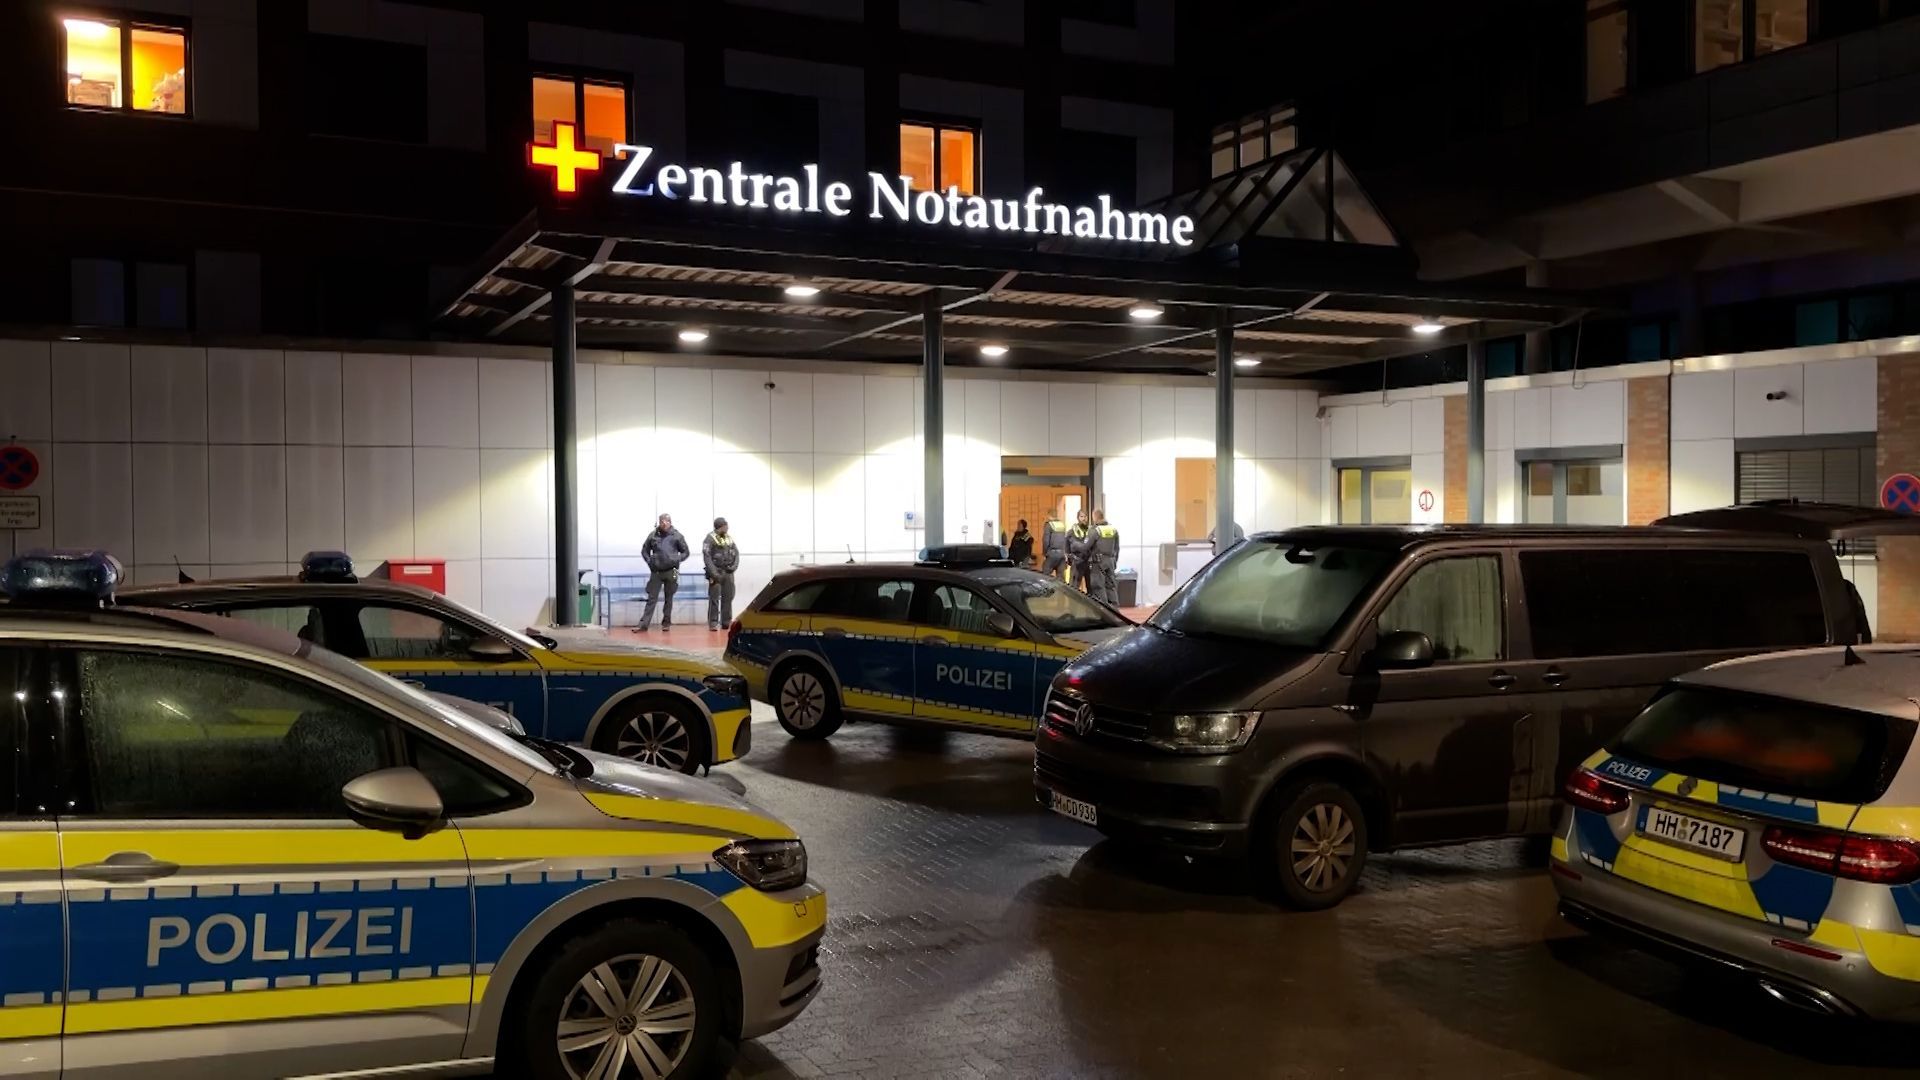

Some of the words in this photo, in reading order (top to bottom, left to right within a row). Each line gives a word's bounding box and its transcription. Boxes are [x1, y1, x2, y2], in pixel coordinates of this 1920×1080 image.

[612, 144, 852, 217] Zentrale
[868, 171, 1195, 247] Notaufnahme
[936, 663, 1012, 690] POLIZEI
[1605, 761, 1652, 781] POLIZEI
[1655, 813, 1679, 837] HH
[1689, 821, 1735, 850] 7187
[146, 905, 414, 968] POLIZEI
